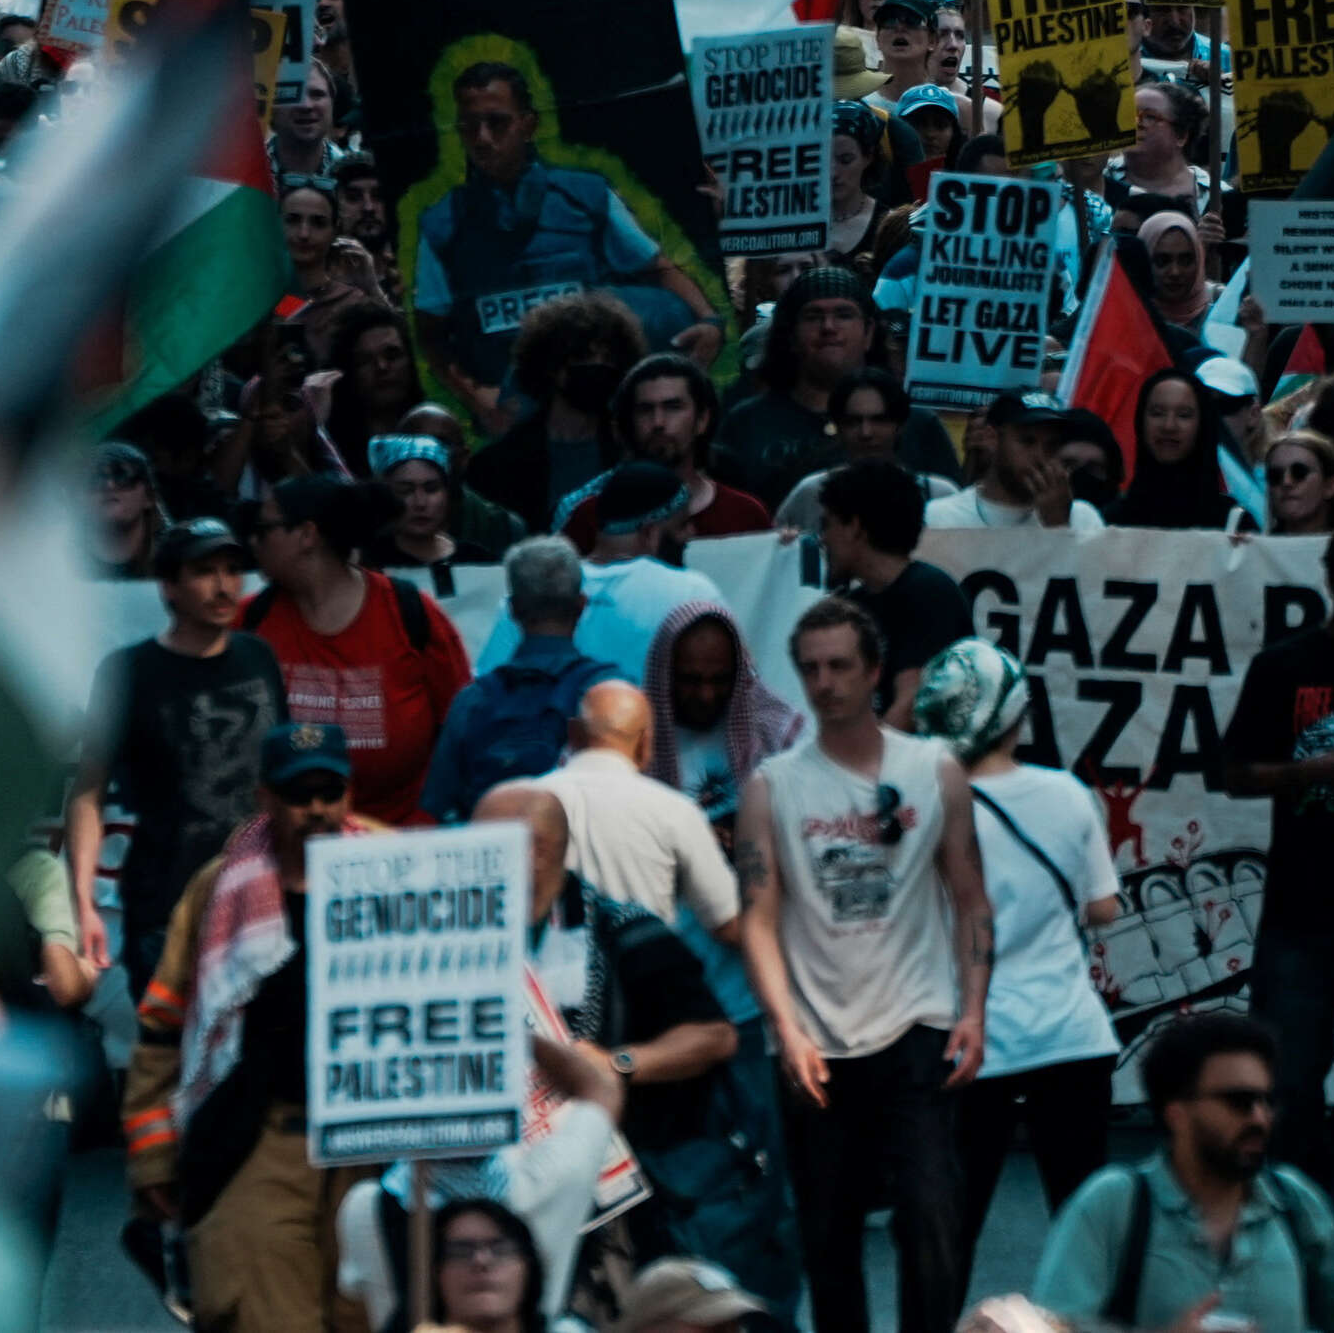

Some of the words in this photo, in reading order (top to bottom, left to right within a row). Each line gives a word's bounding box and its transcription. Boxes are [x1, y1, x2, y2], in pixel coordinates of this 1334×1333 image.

[997, 2, 1125, 56] PALESTINE
[704, 44, 771, 73] STOP
[775, 37, 823, 66] THE
[706, 63, 822, 109] GENOCIDE
[704, 143, 821, 183] FREE
[933, 179, 1051, 239] STOP
[930, 233, 1049, 271] KILLING
[925, 266, 1045, 292] JOURNALISTS
[921, 296, 968, 327] LET
[975, 299, 1040, 333] GAZA
[916, 327, 1037, 369] LIVE
[959, 569, 1233, 676] GAZA
[325, 882, 507, 940] GENOCIDE
[328, 997, 506, 1053] FREE
[326, 1051, 506, 1104] PALESTINE
